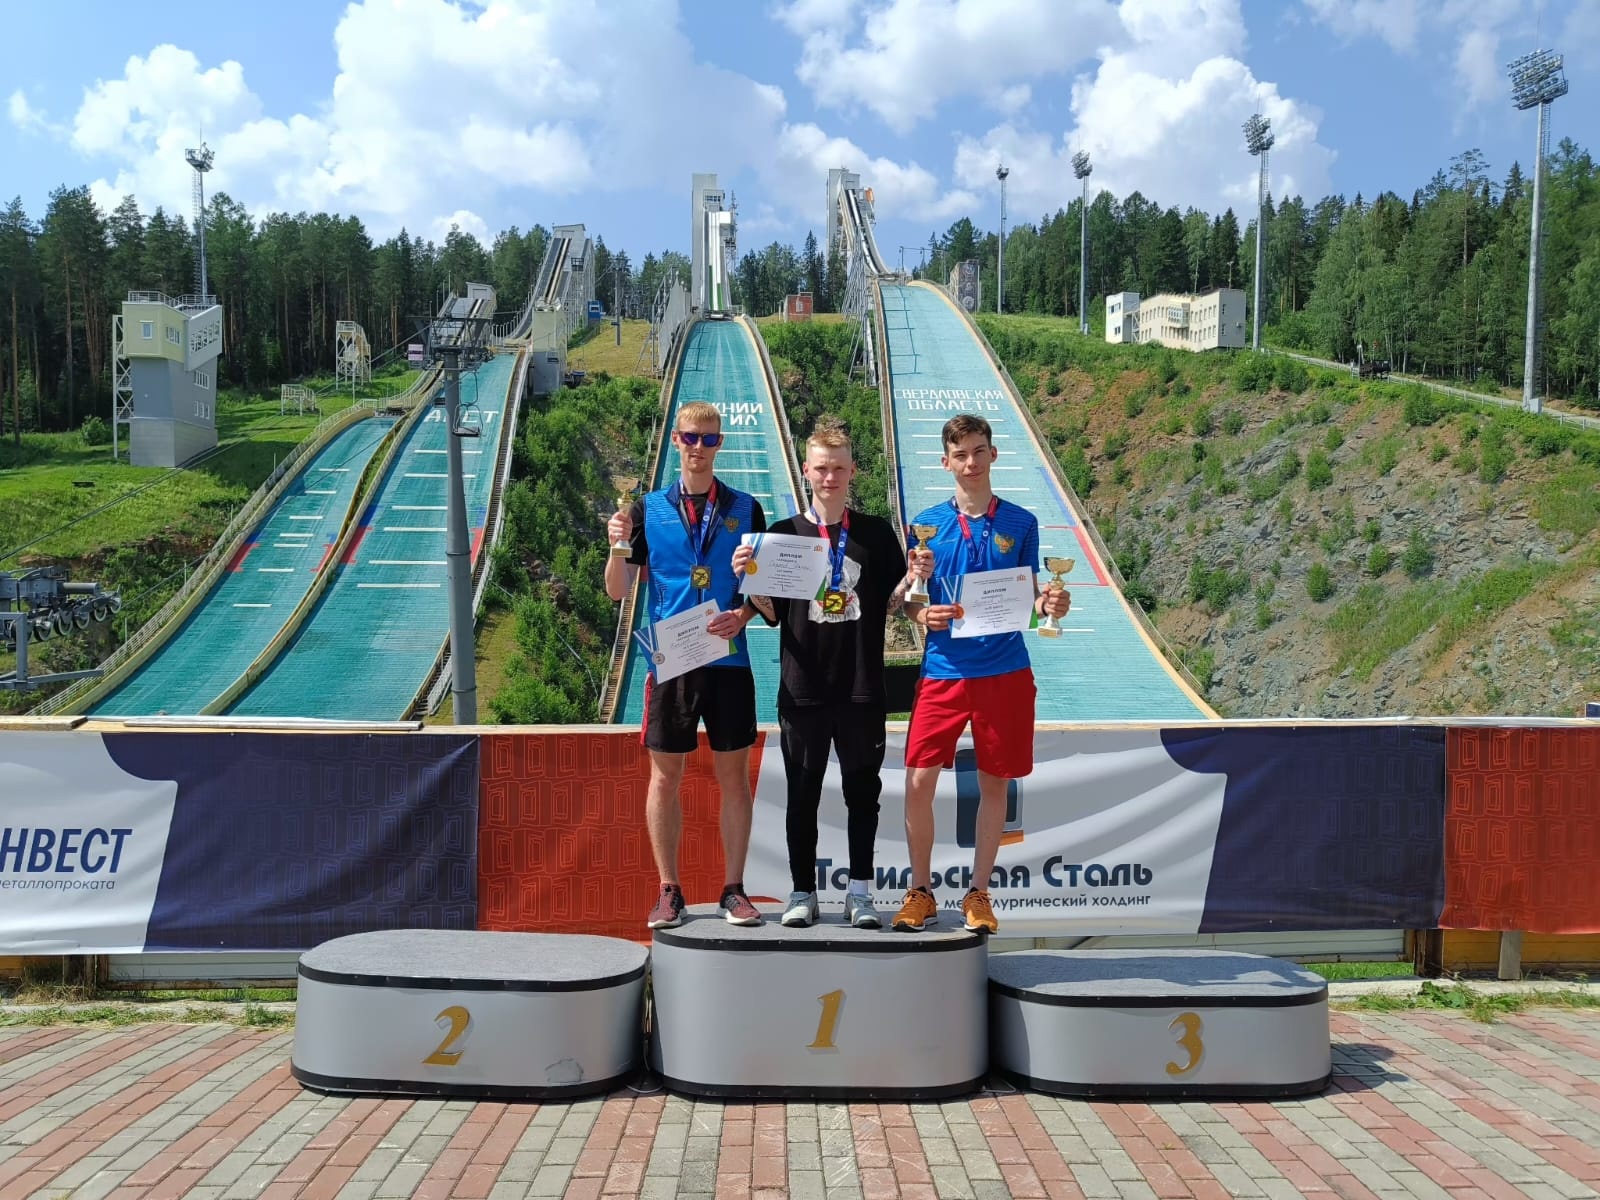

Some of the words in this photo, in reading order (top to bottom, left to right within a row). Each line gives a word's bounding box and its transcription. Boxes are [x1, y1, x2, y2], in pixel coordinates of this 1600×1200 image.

[894, 388, 1004, 400] СВЕРДЛОВСКАЯ
[908, 399, 1000, 411] ОБЛАСТЬ
[1043, 855, 1153, 888] Сталь
[0, 879, 115, 891] еталлопроката
[944, 894, 1087, 911] мелургический
[1092, 895, 1151, 907] холдинг
[805, 988, 843, 1048] 1
[422, 1005, 470, 1066] 2
[1166, 1012, 1203, 1075] 3
